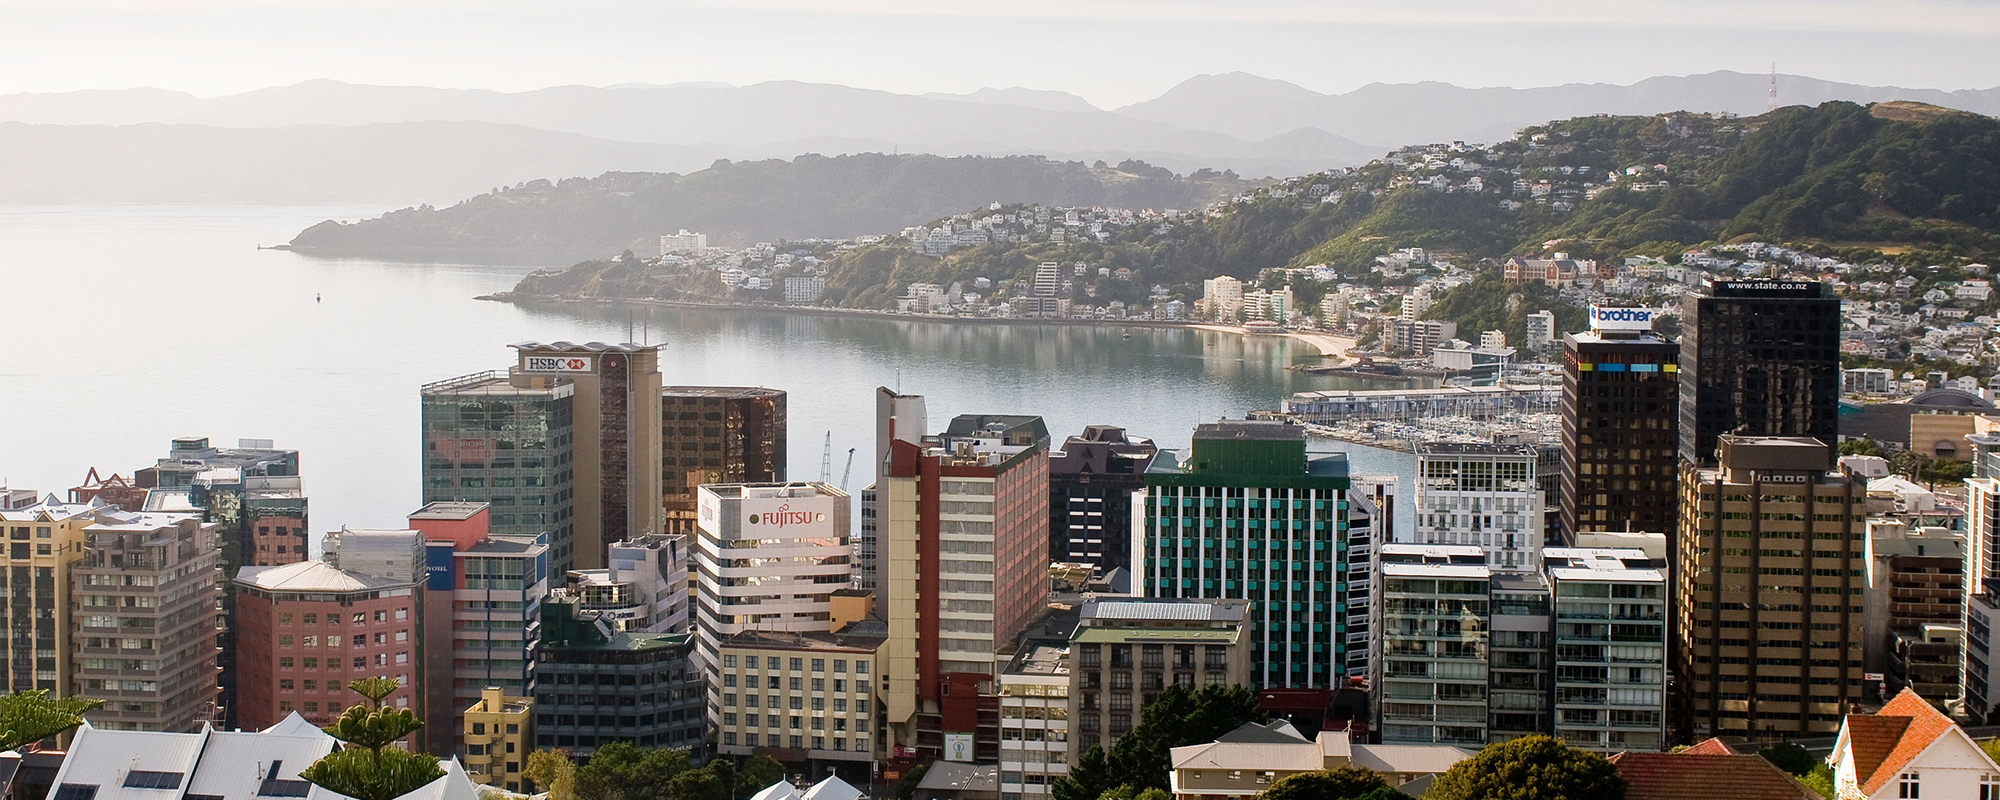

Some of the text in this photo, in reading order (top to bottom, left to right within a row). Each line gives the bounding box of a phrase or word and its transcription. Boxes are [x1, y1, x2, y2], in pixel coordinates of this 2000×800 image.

[1728, 282, 1807, 290] www.state.co.nz
[1599, 309, 1651, 321] brother
[529, 358, 565, 370] HSBC
[763, 504, 812, 528] FUJITSU
